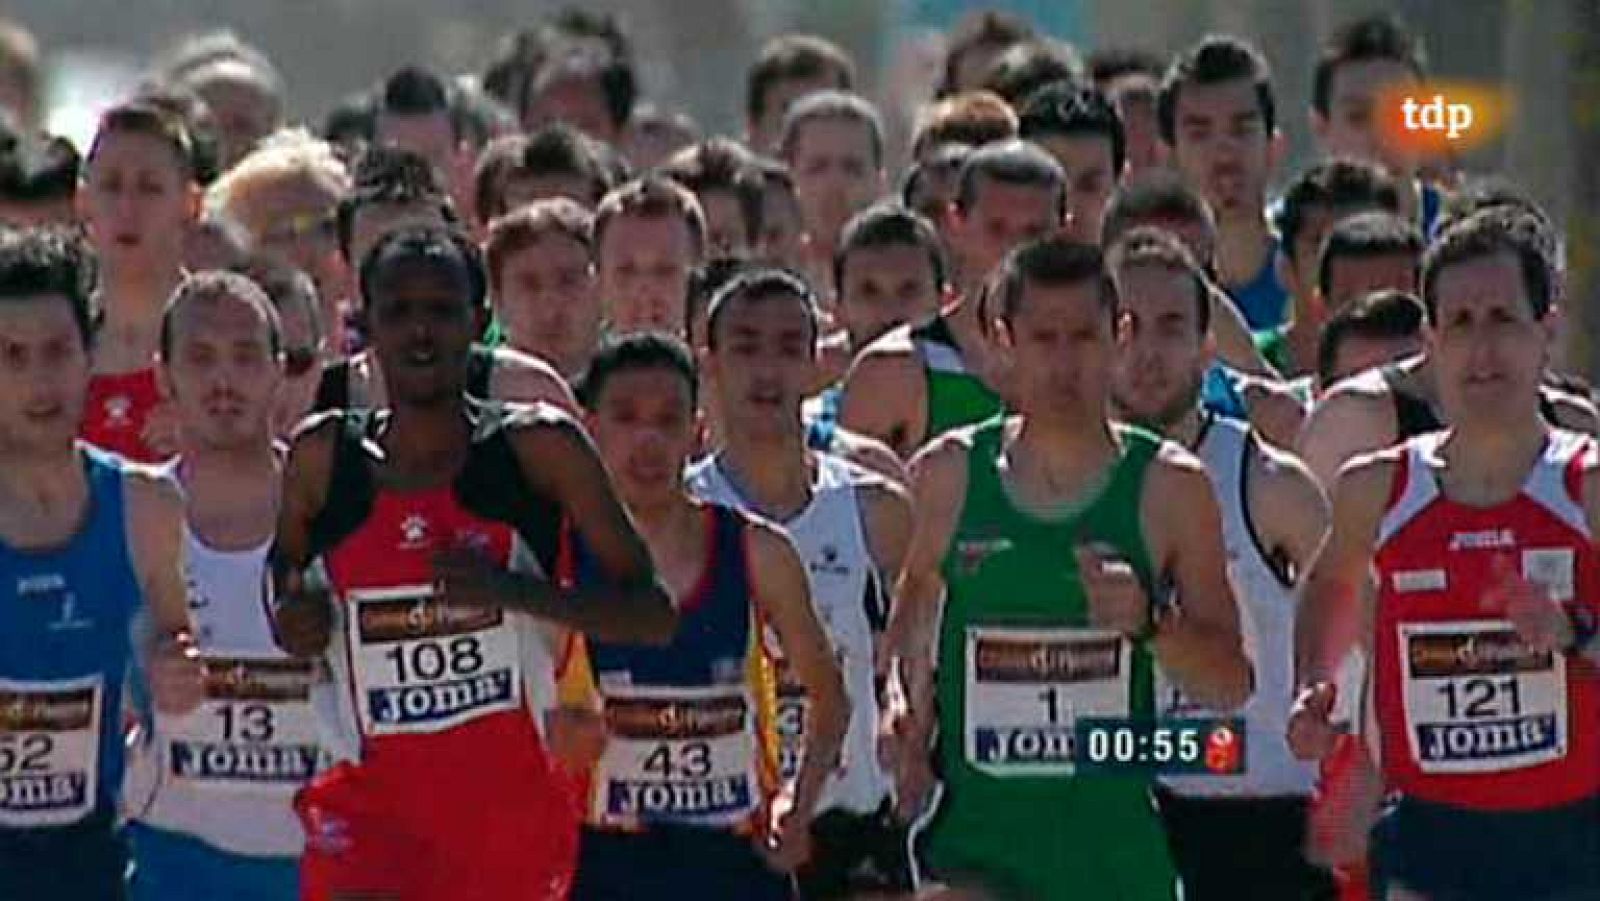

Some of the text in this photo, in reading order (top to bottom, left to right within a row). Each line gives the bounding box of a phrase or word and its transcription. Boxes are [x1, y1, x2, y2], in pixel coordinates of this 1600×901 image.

[386, 637, 483, 683] 108
[1038, 687, 1057, 723] 1
[1436, 678, 1521, 719] 121
[215, 704, 275, 741] 13
[643, 741, 712, 777] 43
